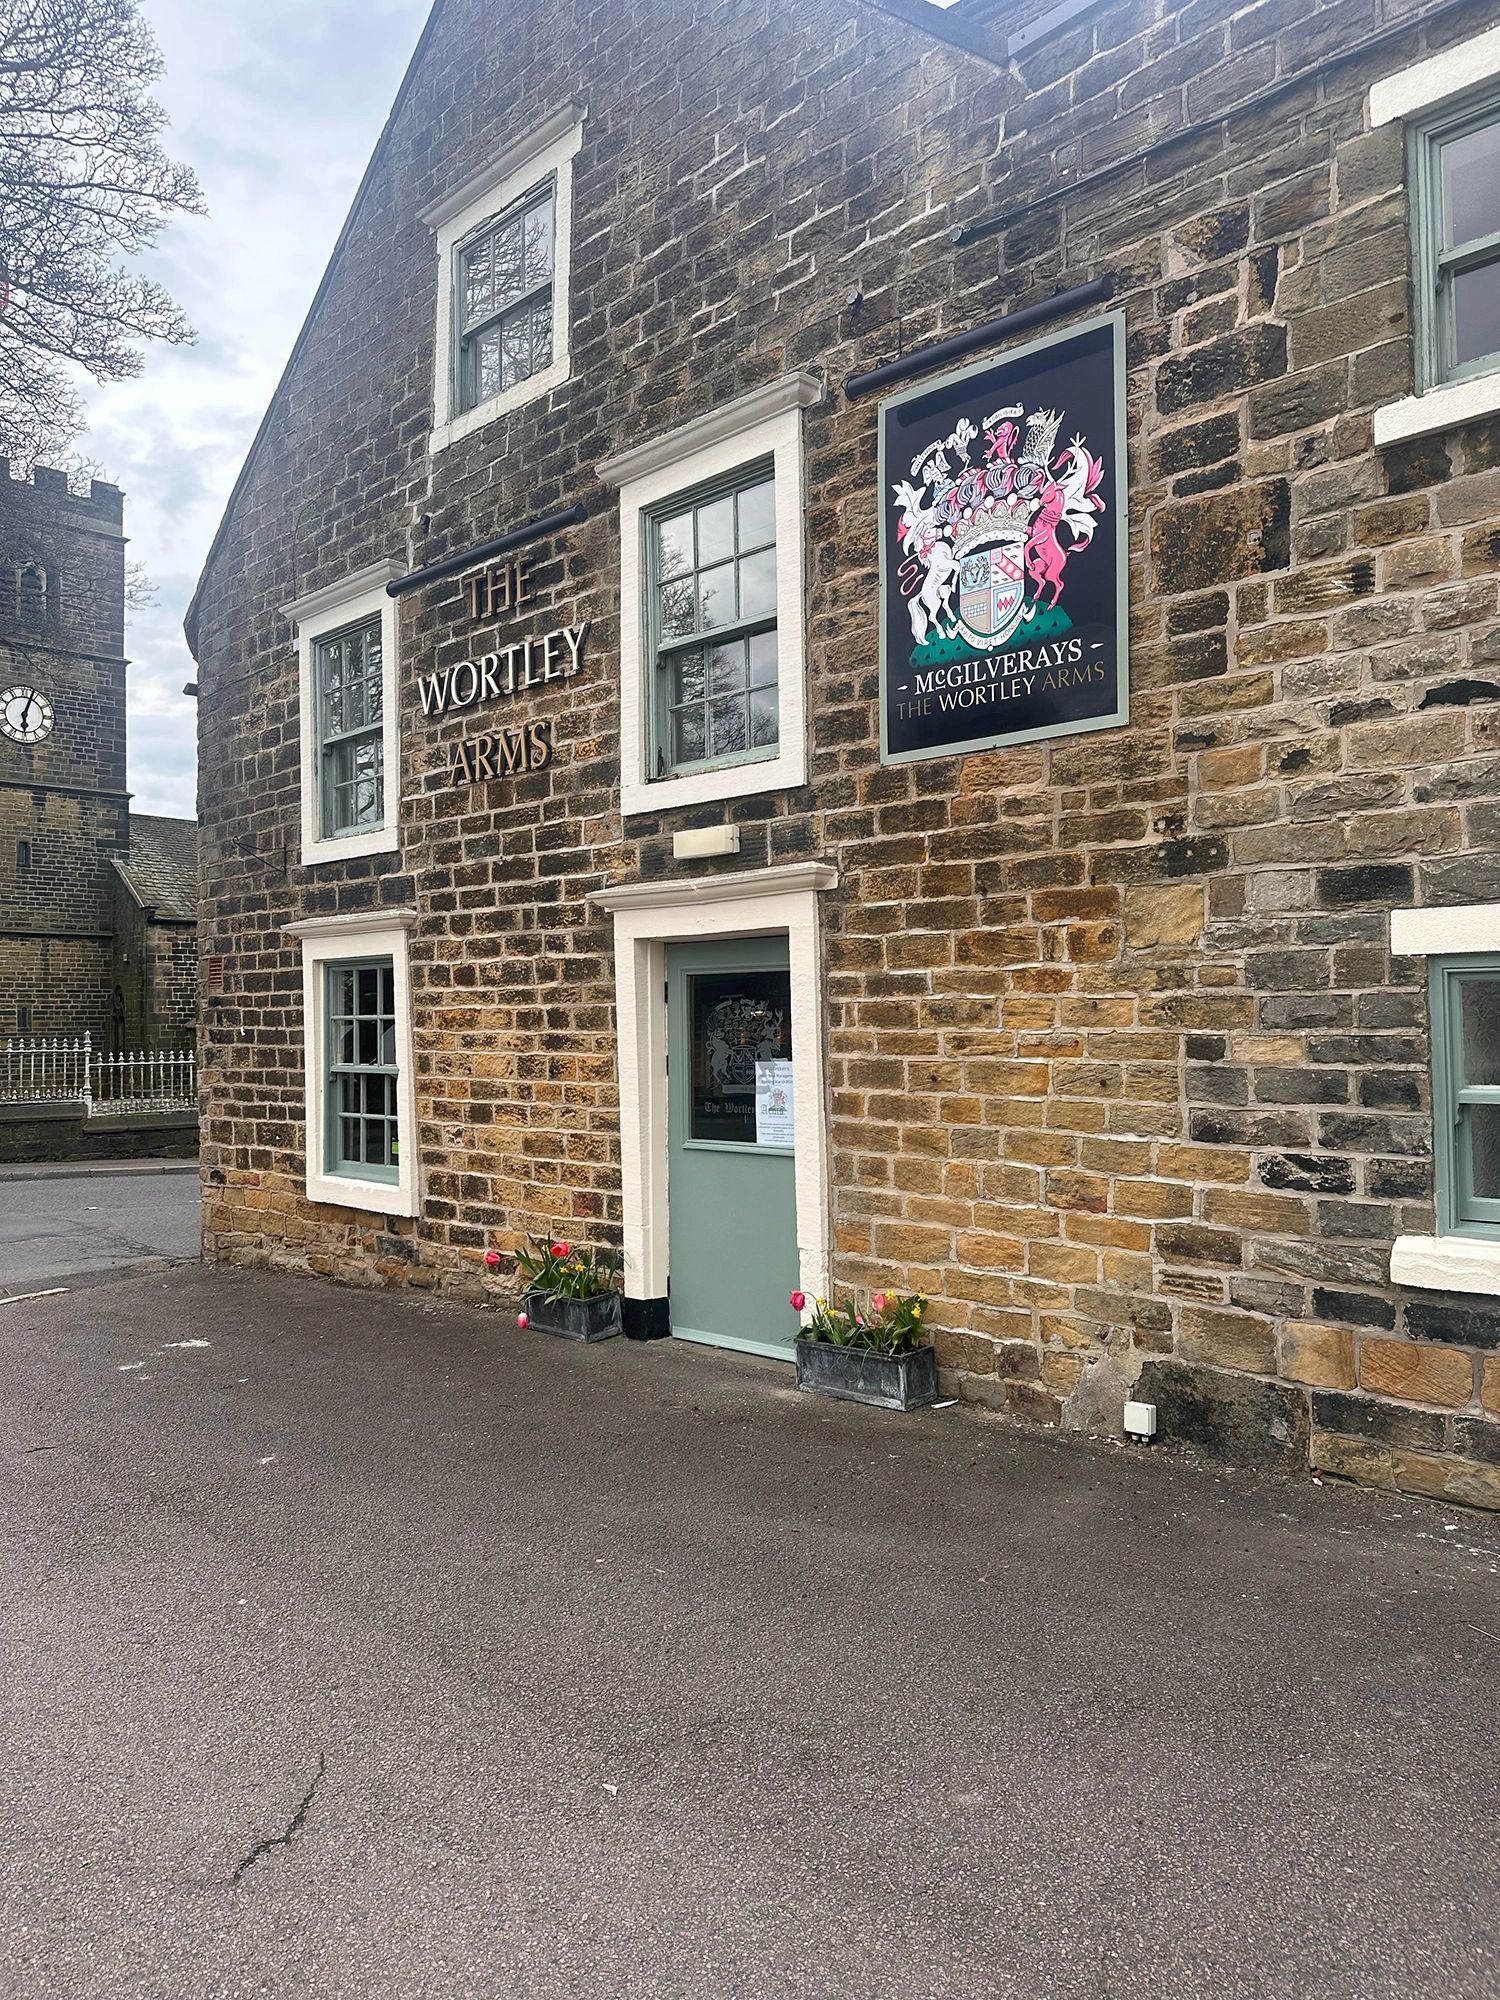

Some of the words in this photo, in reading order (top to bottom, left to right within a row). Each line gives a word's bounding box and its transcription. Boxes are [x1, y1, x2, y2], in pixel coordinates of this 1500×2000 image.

[463, 556, 531, 618] THE
[418, 622, 590, 715] WORTLEY
[896, 697, 932, 720] THE
[938, 675, 1036, 712] WORTLEY
[1041, 660, 1105, 692] ARMS
[450, 722, 550, 786] ARMS
[704, 1101, 720, 1114] The
